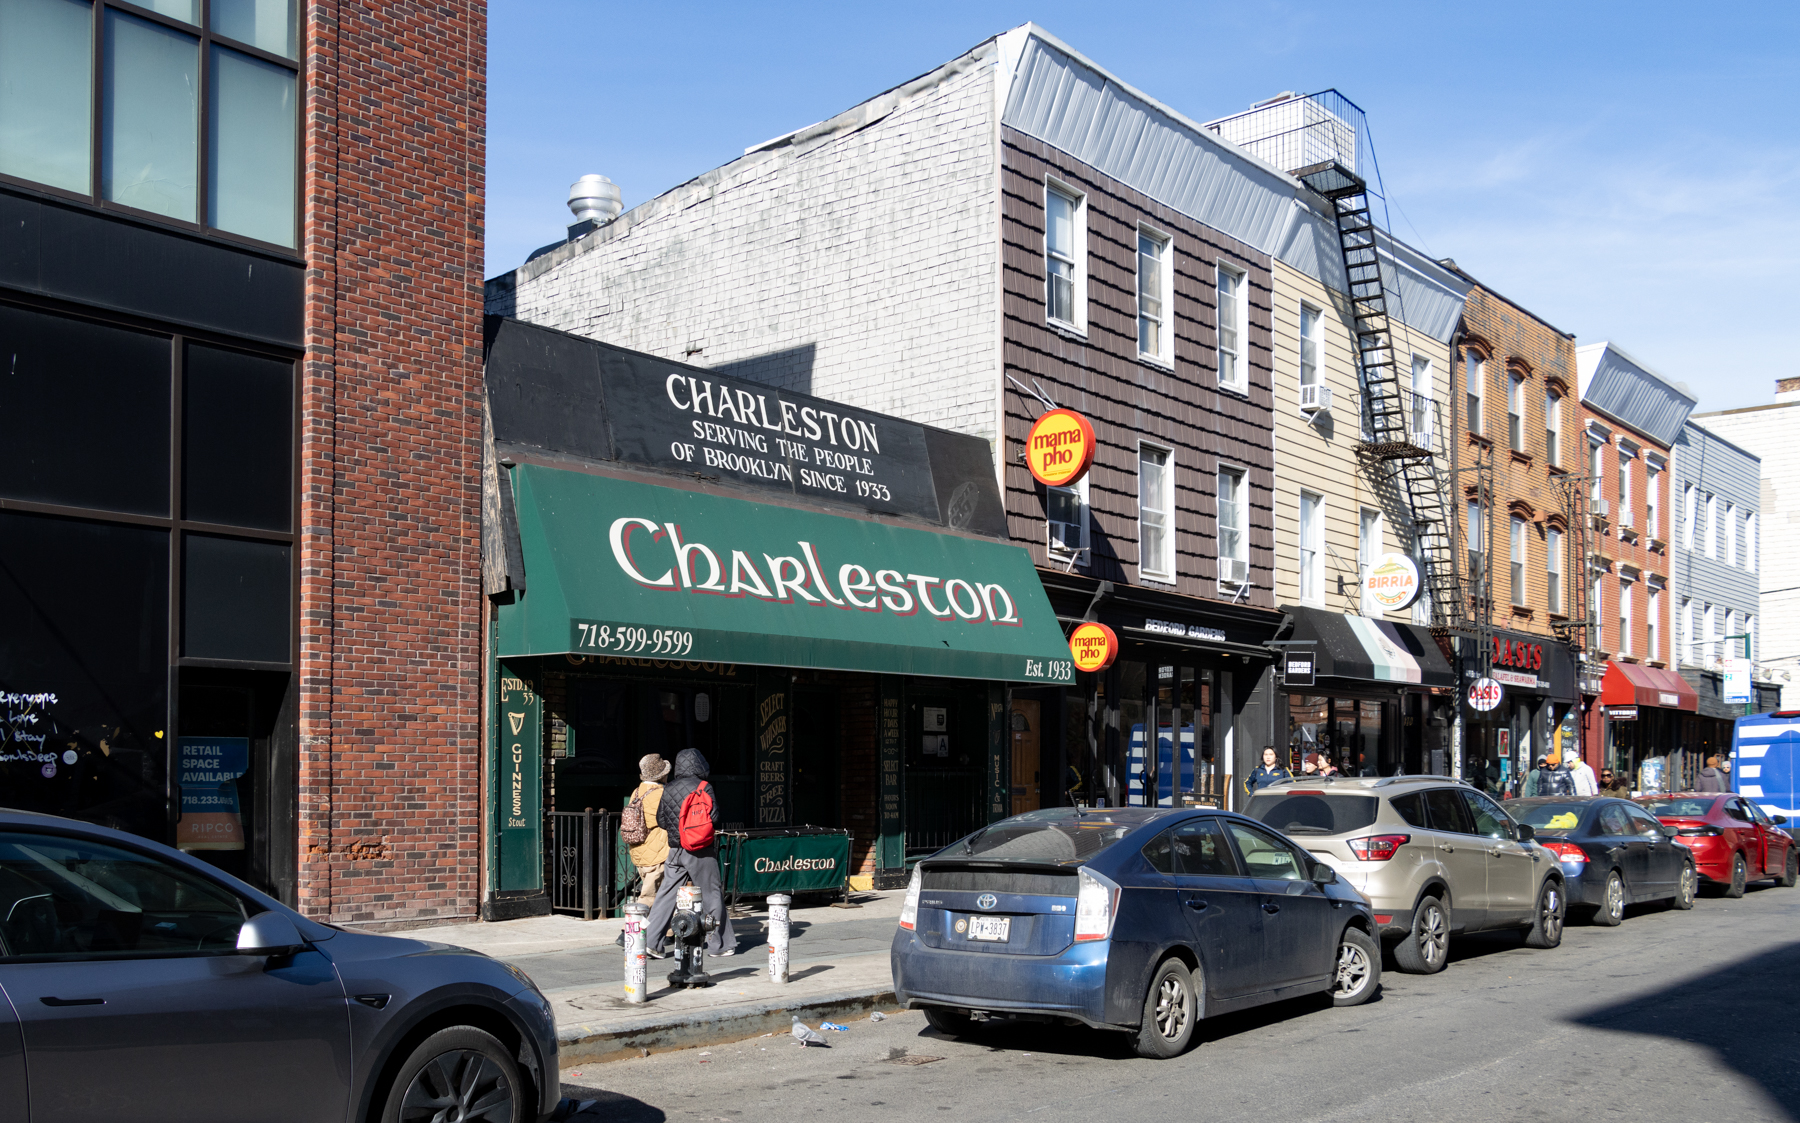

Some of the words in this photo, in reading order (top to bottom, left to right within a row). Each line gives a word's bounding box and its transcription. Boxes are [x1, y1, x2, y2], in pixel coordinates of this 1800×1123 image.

[666, 373, 880, 454] CHARLESTON
[1034, 429, 1081, 450] mama
[692, 420, 768, 453] SERVING
[776, 438, 809, 462] THE
[814, 447, 874, 476] PEOPLE
[1043, 446, 1073, 471] pho
[671, 442, 695, 462] OF
[703, 447, 793, 482] BROOKLYN
[800, 468, 847, 493] SINCE
[855, 479, 891, 502] 1933
[608, 516, 1019, 625] Charleston
[1368, 575, 1413, 589] BIRRIA
[1145, 618, 1185, 635] BEDFORD
[1188, 625, 1226, 642] GARDENS
[577, 623, 693, 655] 718-599-9599
[1074, 636, 1106, 647] mama
[1080, 645, 1100, 662] pho
[1025, 658, 1044, 678] Est.
[1047, 659, 1072, 680] 1933
[522, 692, 534, 705] 33
[1470, 685, 1499, 700] OASIS
[760, 693, 785, 727] SELECT
[883, 699, 898, 707] HAPPY
[883, 708, 898, 717] HOUR
[883, 719, 887, 728] 7
[887, 719, 899, 728] DAYS
[887, 729, 900, 738] WEEK
[183, 745, 223, 756] RETAIL
[182, 759, 220, 769] SPACE
[760, 761, 785, 771] CRAFT
[883, 760, 899, 772] SELECT
[511, 743, 522, 816] GUINNESS
[760, 773, 785, 782] BEERS
[885, 774, 898, 786] BAR
[760, 785, 785, 806] FREE
[759, 807, 786, 822] PIZZA
[191, 822, 233, 833] RIPCO
[508, 817, 526, 828] Stout
[754, 855, 836, 874] Charleston
[989, 922, 1007, 936] 3837
